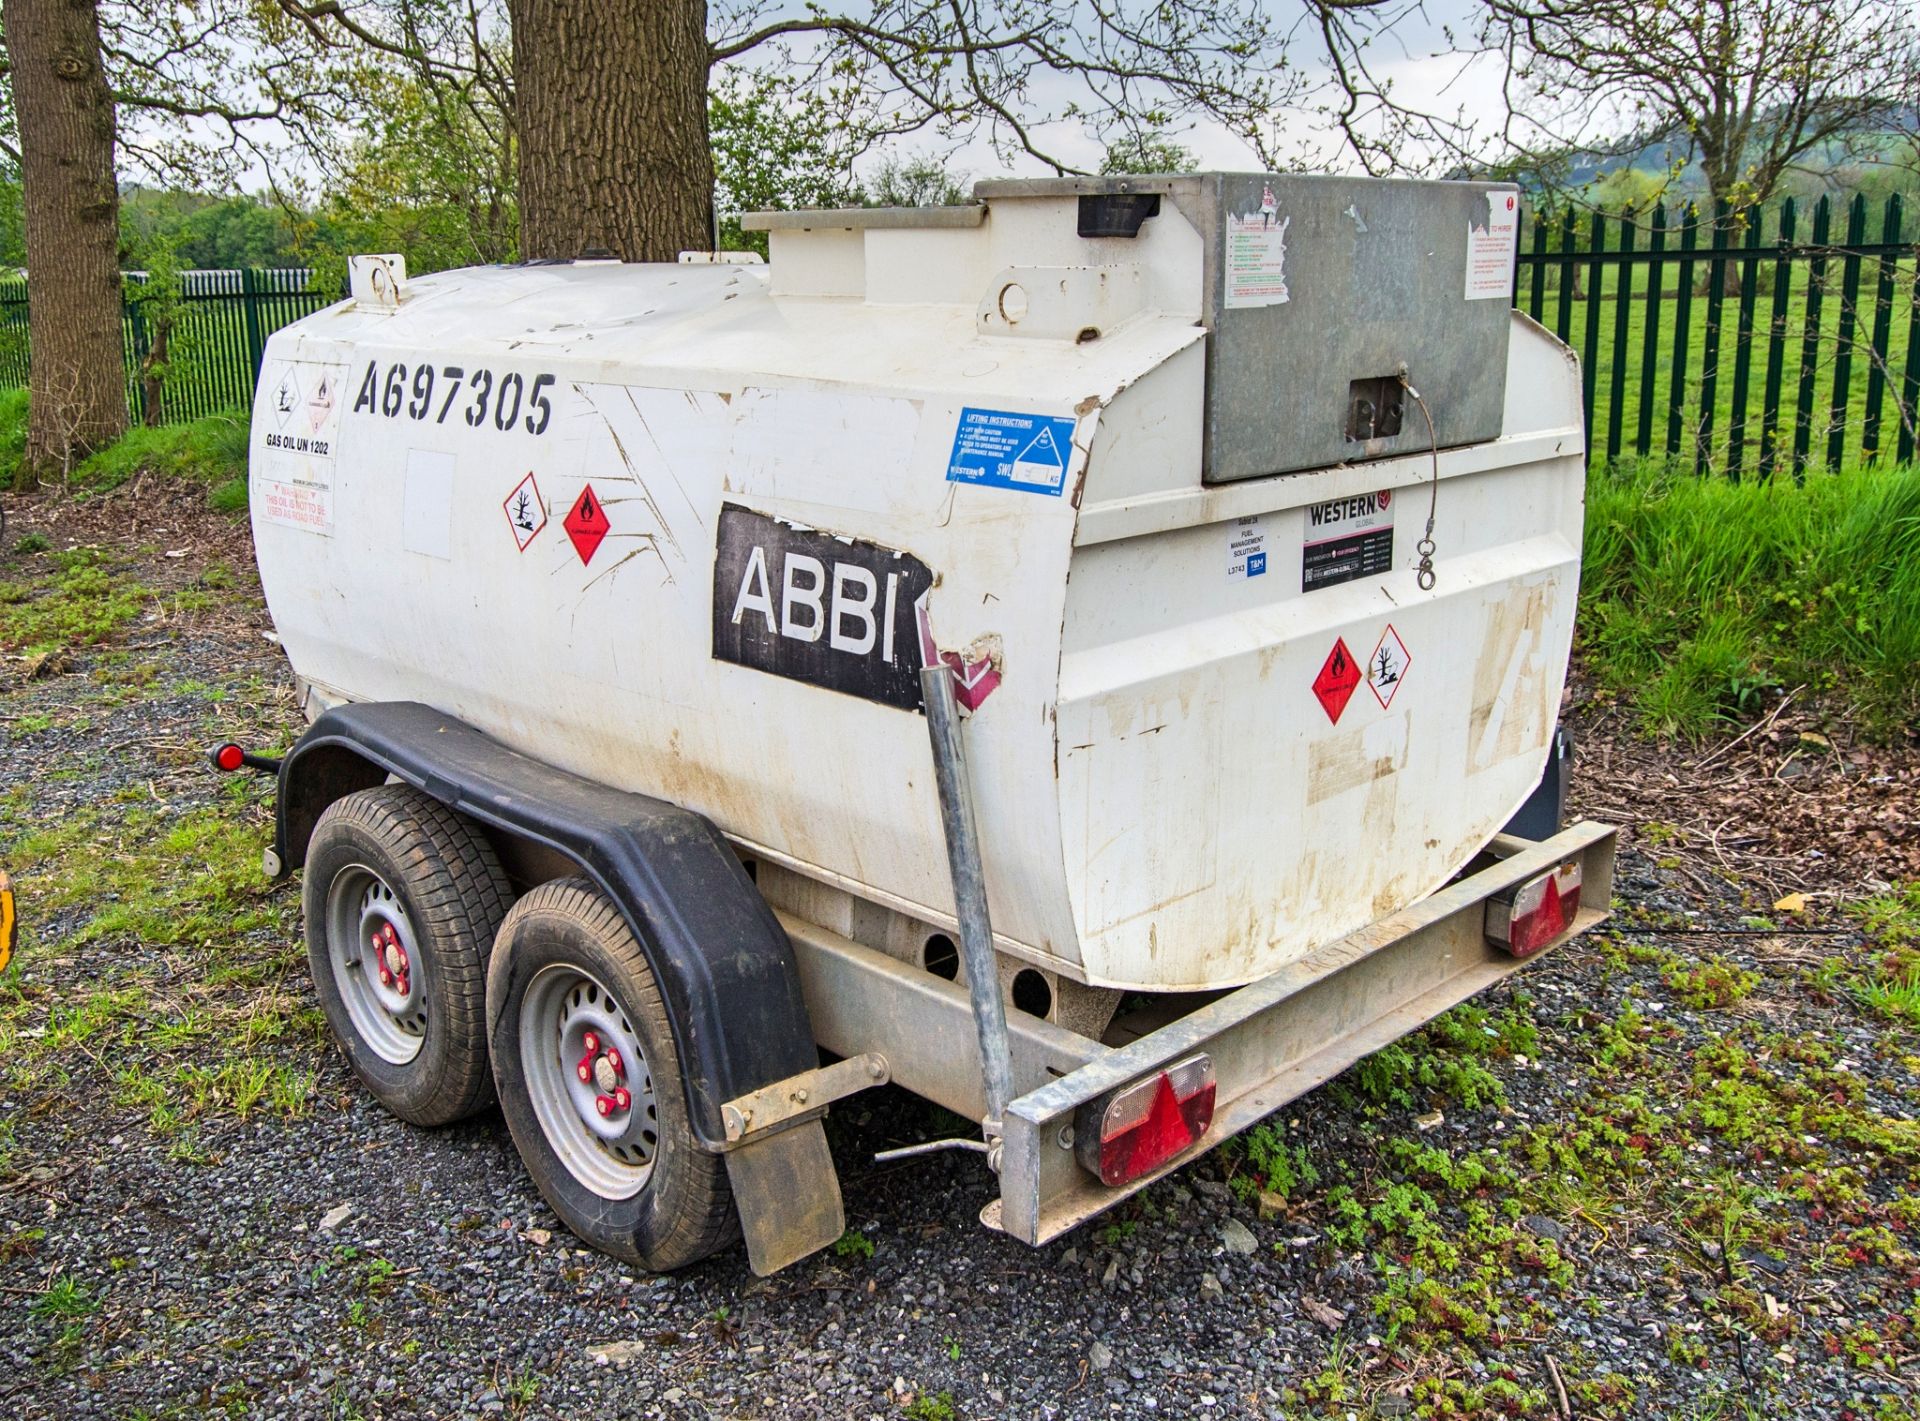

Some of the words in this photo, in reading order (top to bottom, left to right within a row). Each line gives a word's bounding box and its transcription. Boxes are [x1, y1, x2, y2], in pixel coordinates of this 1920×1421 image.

[353, 360, 556, 436] A697305
[967, 413, 989, 425] LIFTING
[989, 415, 1033, 429] INSTRUCTIONS
[266, 433, 282, 447] GAS
[283, 436, 295, 450] OIL
[297, 438, 308, 451] UN
[311, 440, 328, 455] 1202
[996, 463, 1012, 477] SWL
[1050, 475, 1059, 483] KG
[265, 494, 278, 505] THIS
[279, 497, 288, 507] OIL
[294, 500, 307, 511] NOT
[308, 502, 316, 513] TO
[317, 504, 326, 515] BE
[1310, 495, 1376, 527] WESTERN
[267, 506, 282, 517] USED
[292, 511, 308, 523] ROAD
[310, 515, 325, 527] FUEL
[1355, 518, 1375, 528] GLOBAL
[1231, 535, 1264, 549] MANAGEMENT
[1233, 546, 1261, 557] SOLUTIONS
[1250, 558, 1264, 569] T&M
[731, 546, 898, 664] ABBI
